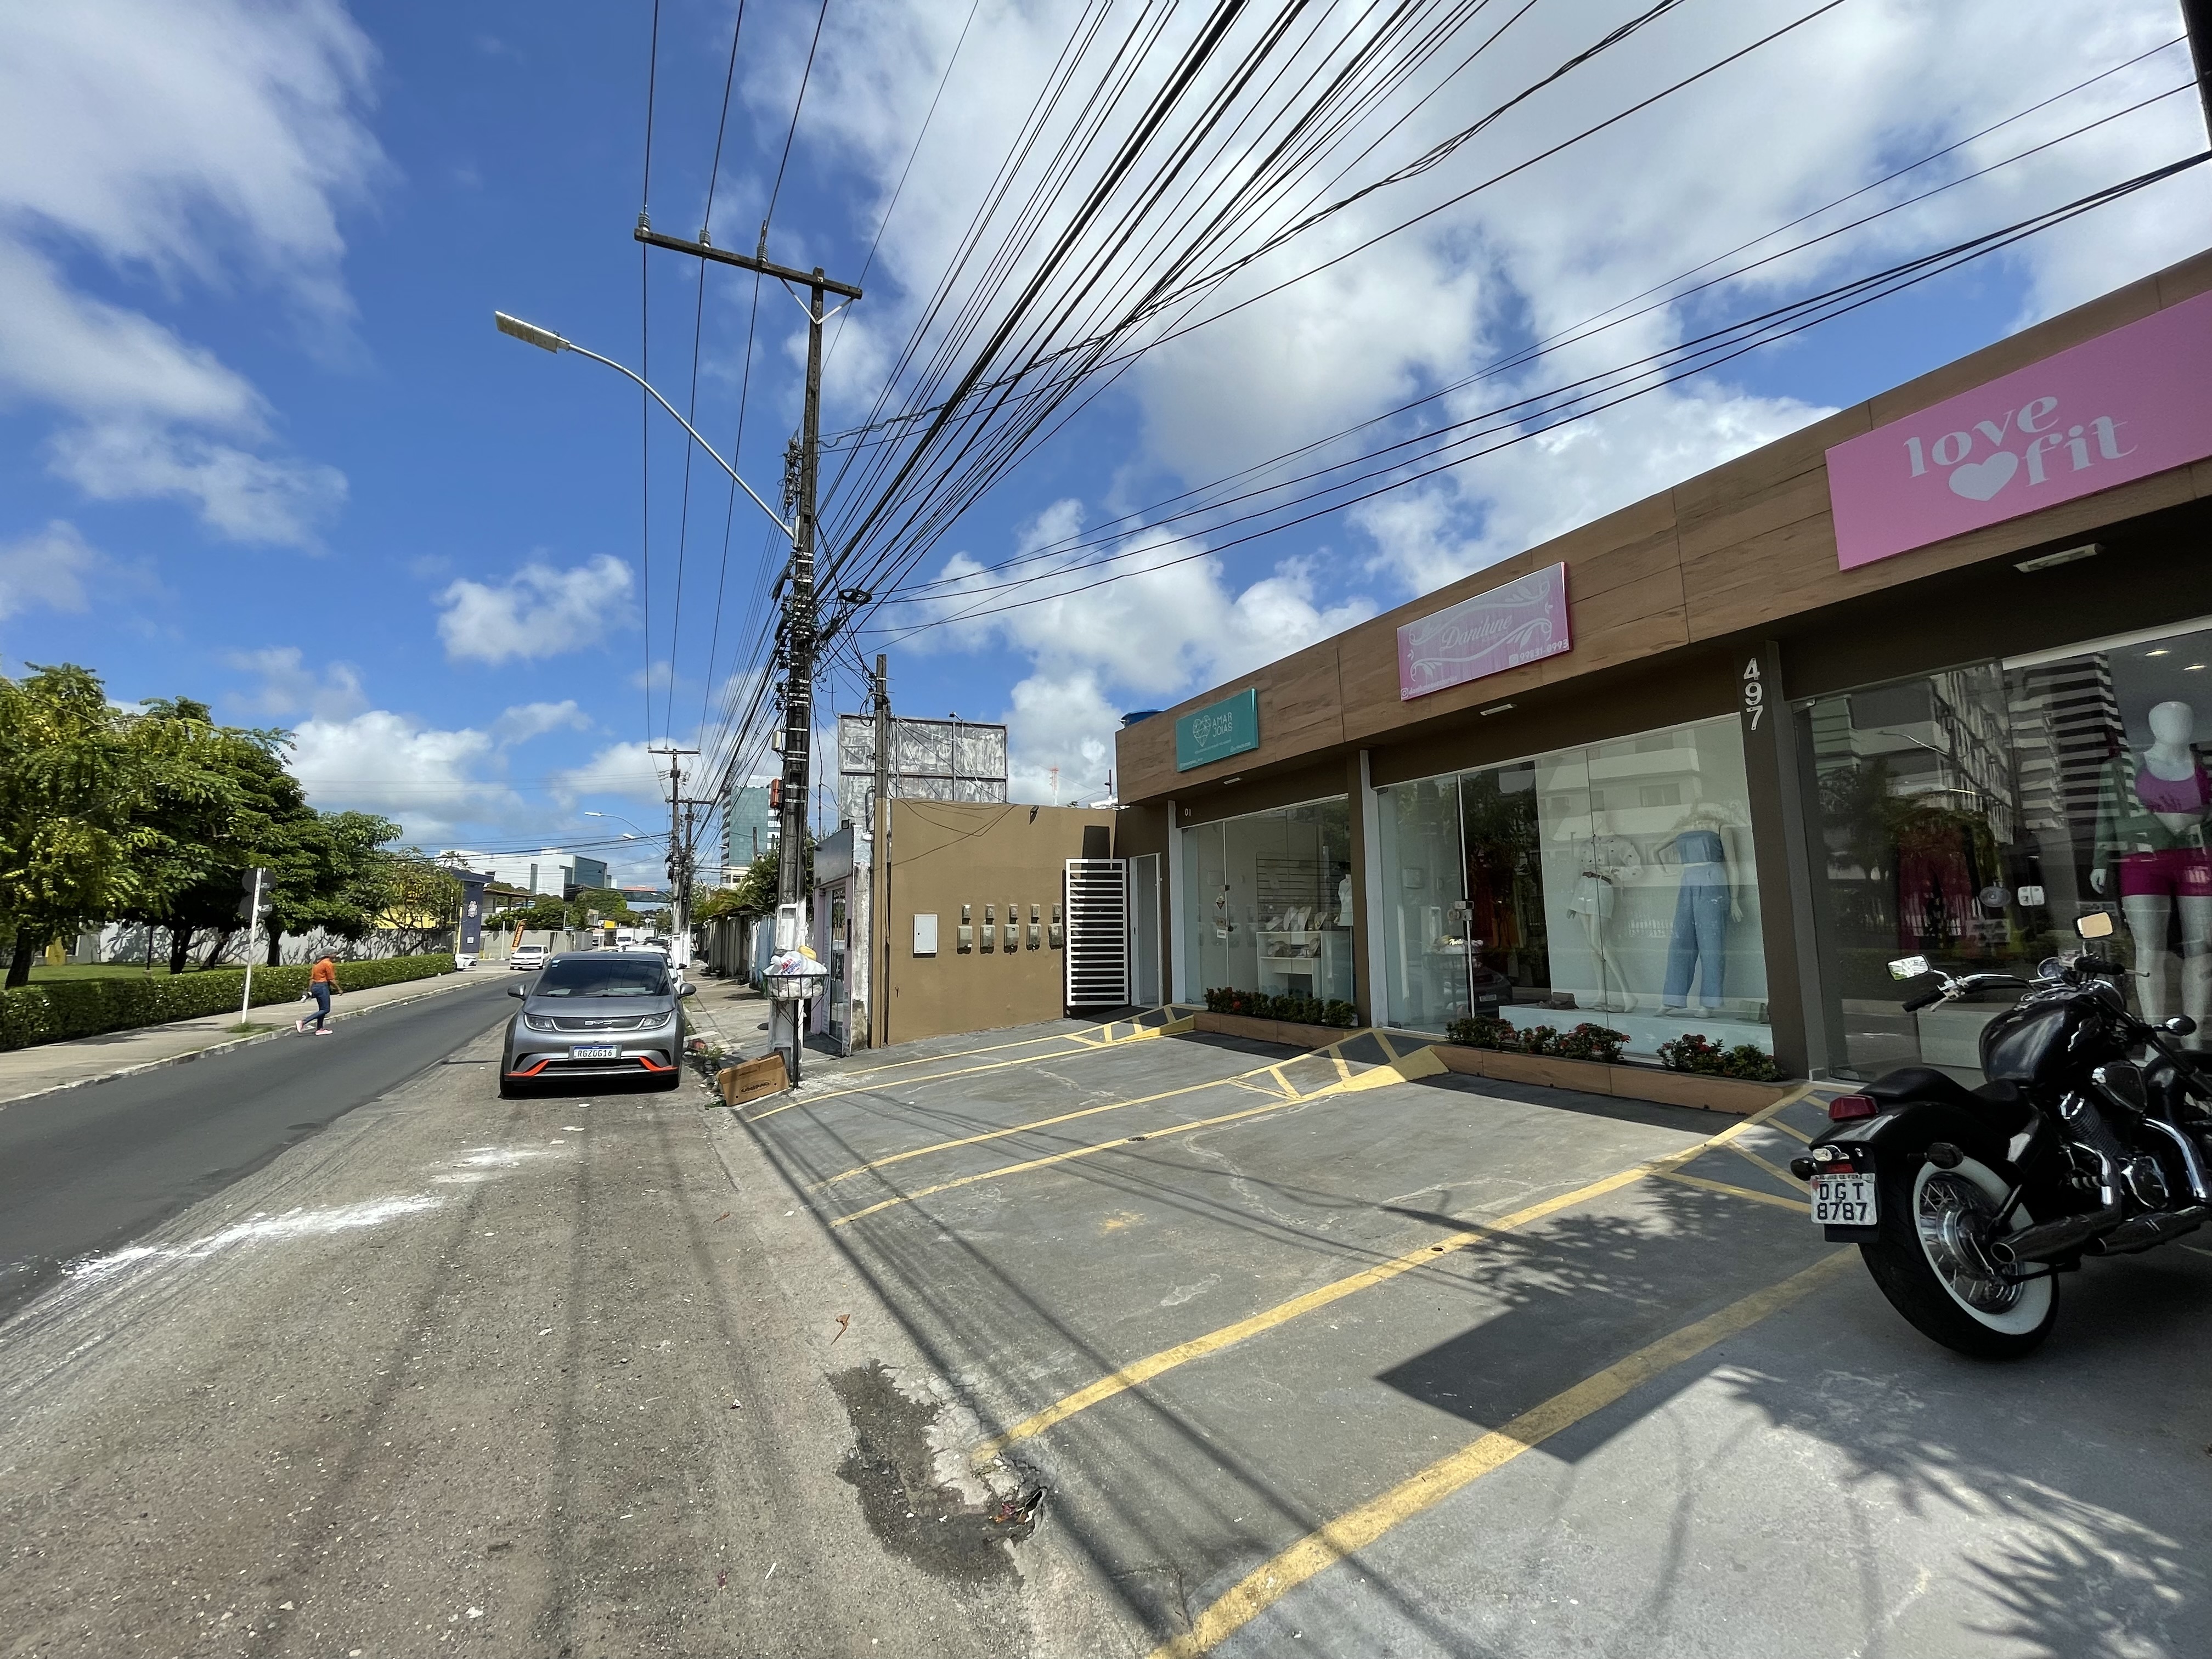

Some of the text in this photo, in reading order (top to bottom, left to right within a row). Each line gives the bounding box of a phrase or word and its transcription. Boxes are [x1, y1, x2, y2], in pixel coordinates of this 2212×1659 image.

[1903, 396, 2059, 478] love
[2022, 415, 2138, 488] fit
[1743, 658, 1763, 730] 497
[1212, 712, 1232, 727] AMAR
[1212, 722, 1233, 737] JOIAS
[1184, 808, 1191, 817] 01
[1819, 1182, 1864, 1200] DGT
[1817, 1203, 1867, 1221] 8787
